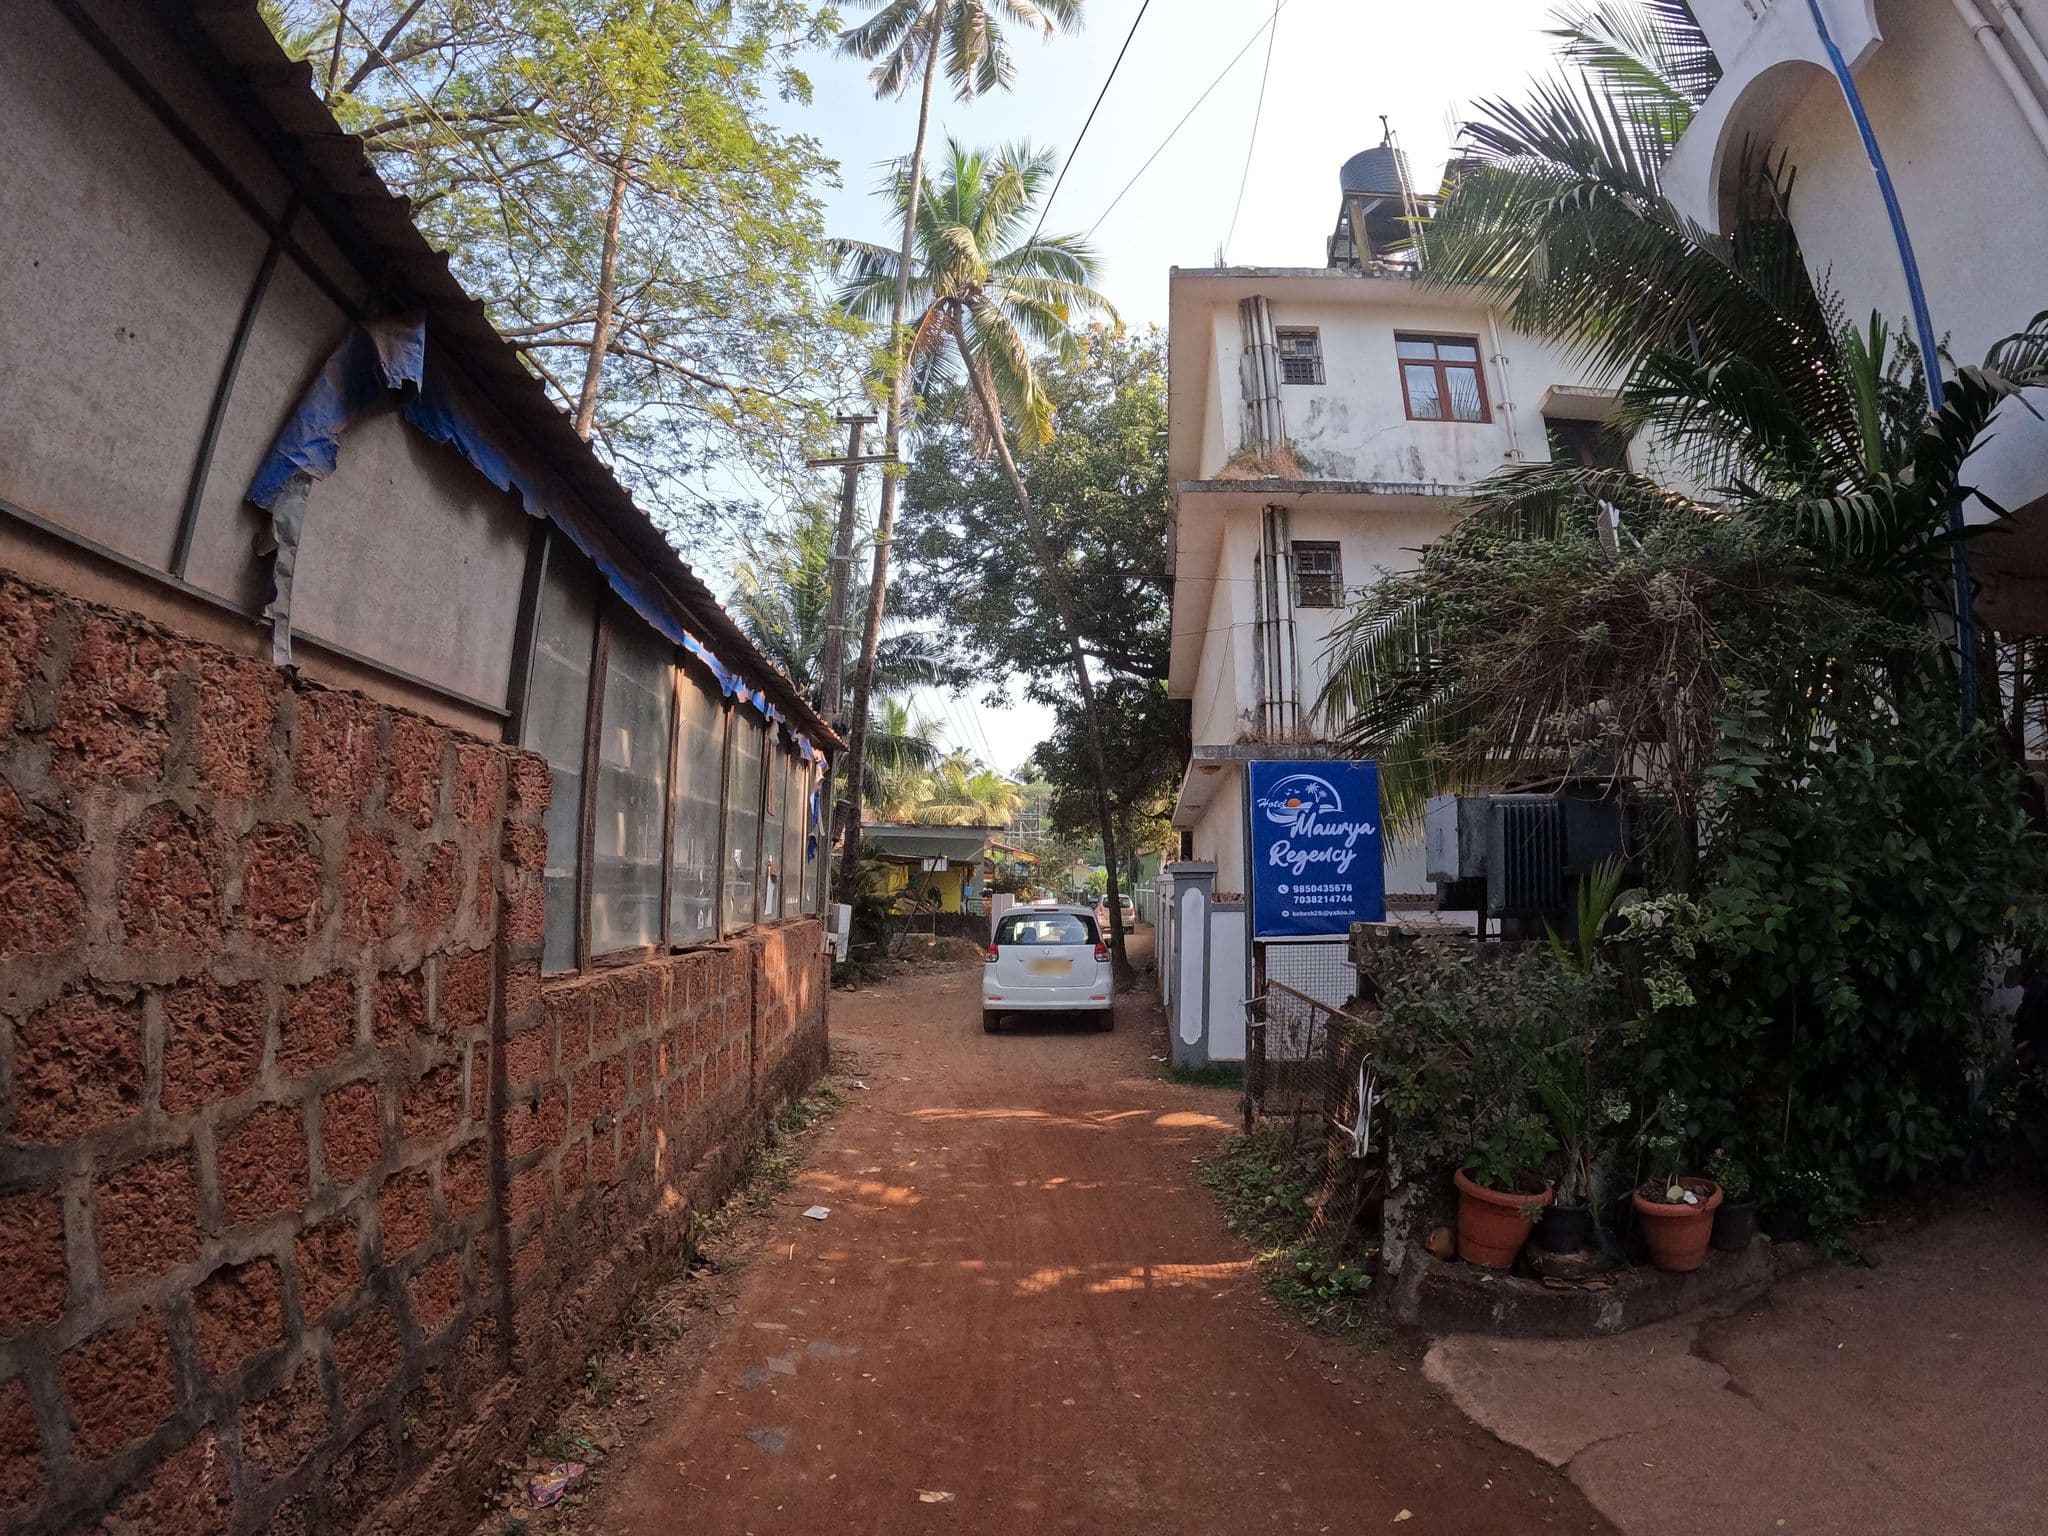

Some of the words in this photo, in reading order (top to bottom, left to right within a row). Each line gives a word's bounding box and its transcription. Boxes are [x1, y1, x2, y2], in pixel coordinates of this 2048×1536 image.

[1257, 798, 1287, 808] Hotel
[1290, 812, 1375, 848] Maurya
[1269, 840, 1357, 876] Regency
